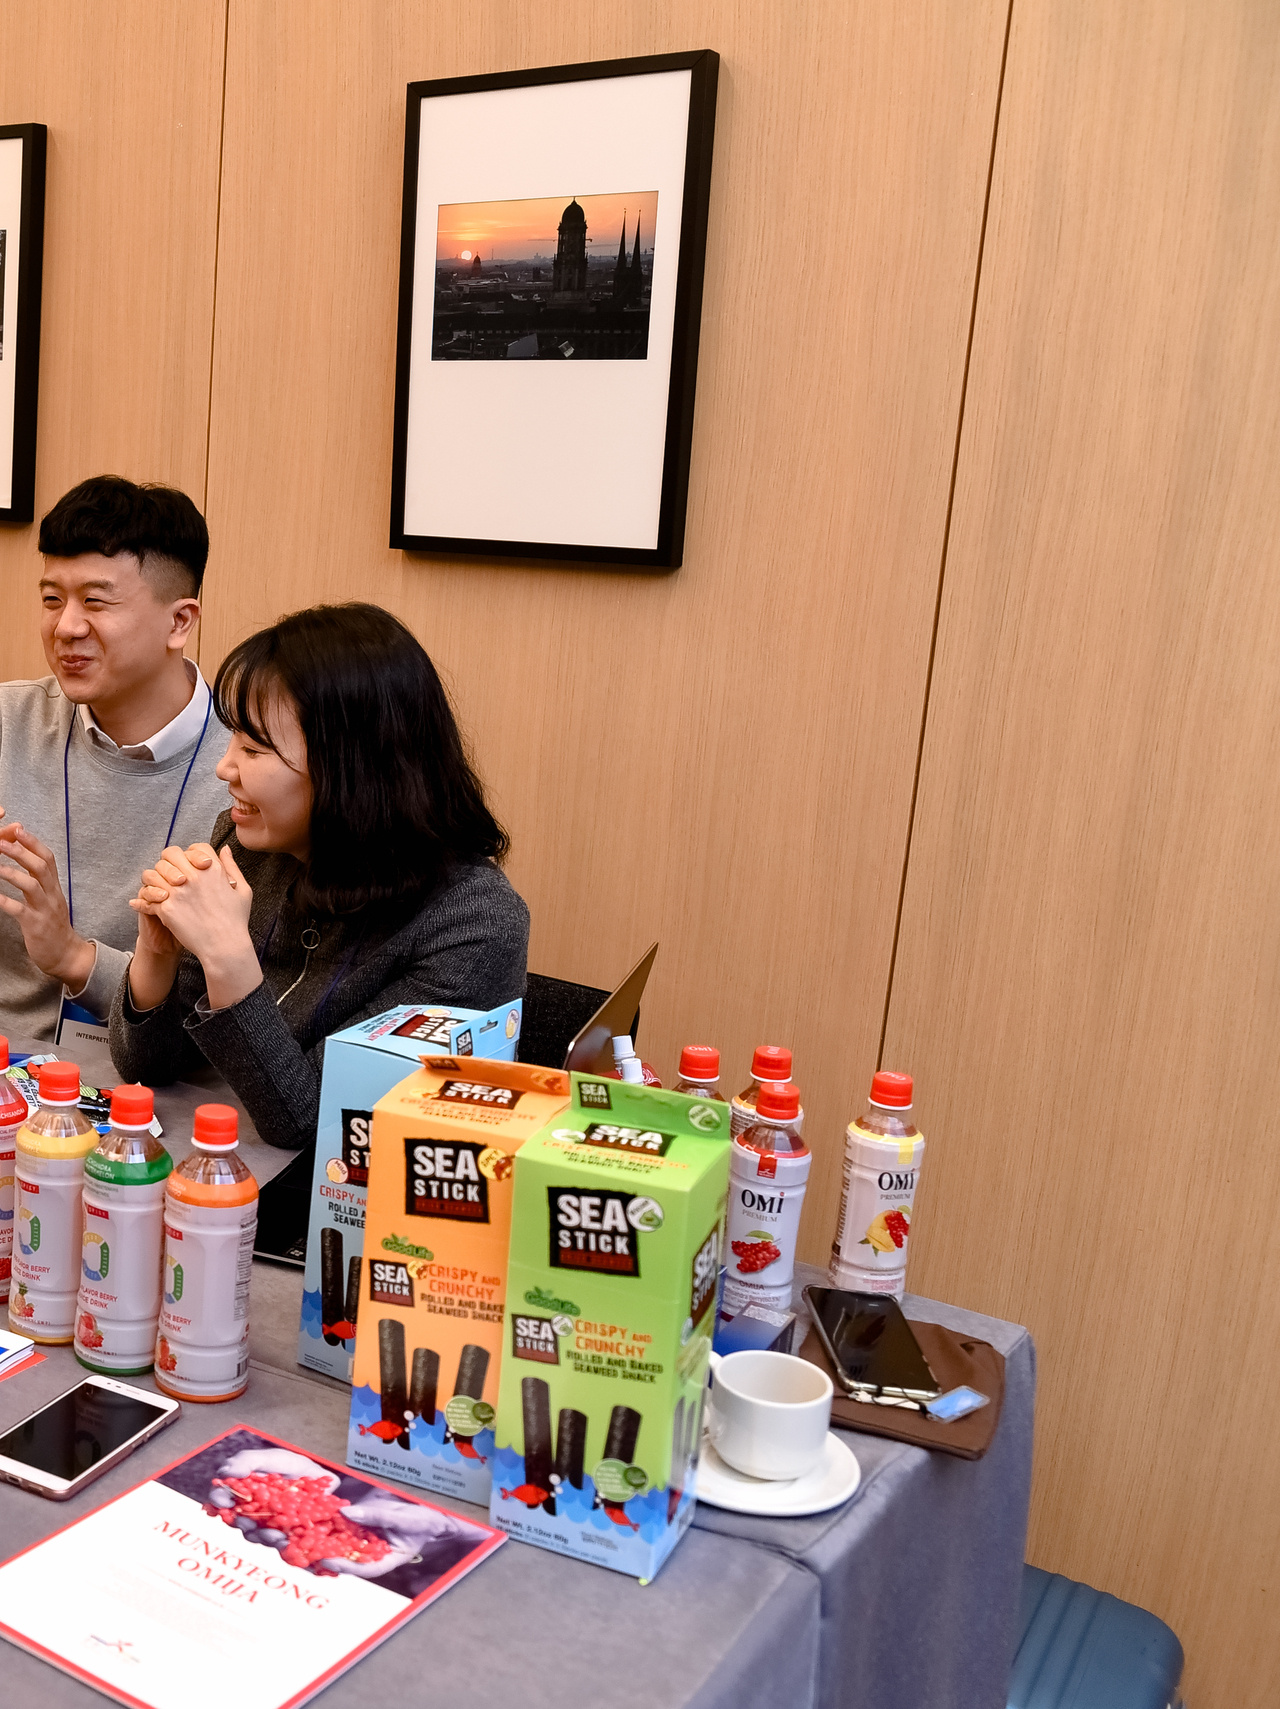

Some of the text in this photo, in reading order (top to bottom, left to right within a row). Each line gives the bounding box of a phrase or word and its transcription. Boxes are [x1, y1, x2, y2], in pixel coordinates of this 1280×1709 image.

[410, 1017, 444, 1039] STICK
[457, 1031, 471, 1049] SEA
[444, 1090, 510, 1105] STICK
[450, 1082, 513, 1099] SEA
[581, 1083, 607, 1096] SEA
[589, 1132, 661, 1150] STICK
[595, 1123, 663, 1144] SEA
[413, 1146, 480, 1182] SEA
[320, 1185, 355, 1203] CRISPY
[414, 1180, 480, 1203] STICK
[880, 1193, 911, 1201] PREMIUM
[328, 1202, 359, 1217] ROLLED
[557, 1194, 630, 1233] SEA
[742, 1209, 779, 1223] PREMIUM
[558, 1229, 630, 1256] STICK
[22, 1271, 40, 1281] DRINK
[31, 1265, 50, 1274] BERRY
[374, 1263, 410, 1285] SEA
[429, 1264, 501, 1287] CRISPY AND
[99, 1290, 118, 1302] BERRY
[374, 1282, 410, 1297] STICK
[429, 1279, 495, 1301] CRUNCHY
[90, 1298, 108, 1309] DRINK
[421, 1293, 455, 1307] ROLLED
[458, 1299, 477, 1310] AND
[172, 1314, 192, 1326] BERRY
[427, 1304, 469, 1319] SEAWEED
[516, 1317, 555, 1341] SEA
[574, 1319, 653, 1344] CRISPY AND
[516, 1337, 555, 1354] STICK
[575, 1336, 646, 1359] CRUNCHY
[566, 1350, 664, 1374] ROLLED AND BAKED
[573, 1362, 657, 1384] SEAWEED SNACK
[354, 1450, 368, 1460] Net
[153, 1520, 330, 1610] MUNKYEONG
[177, 1557, 259, 1604] OMIJA
